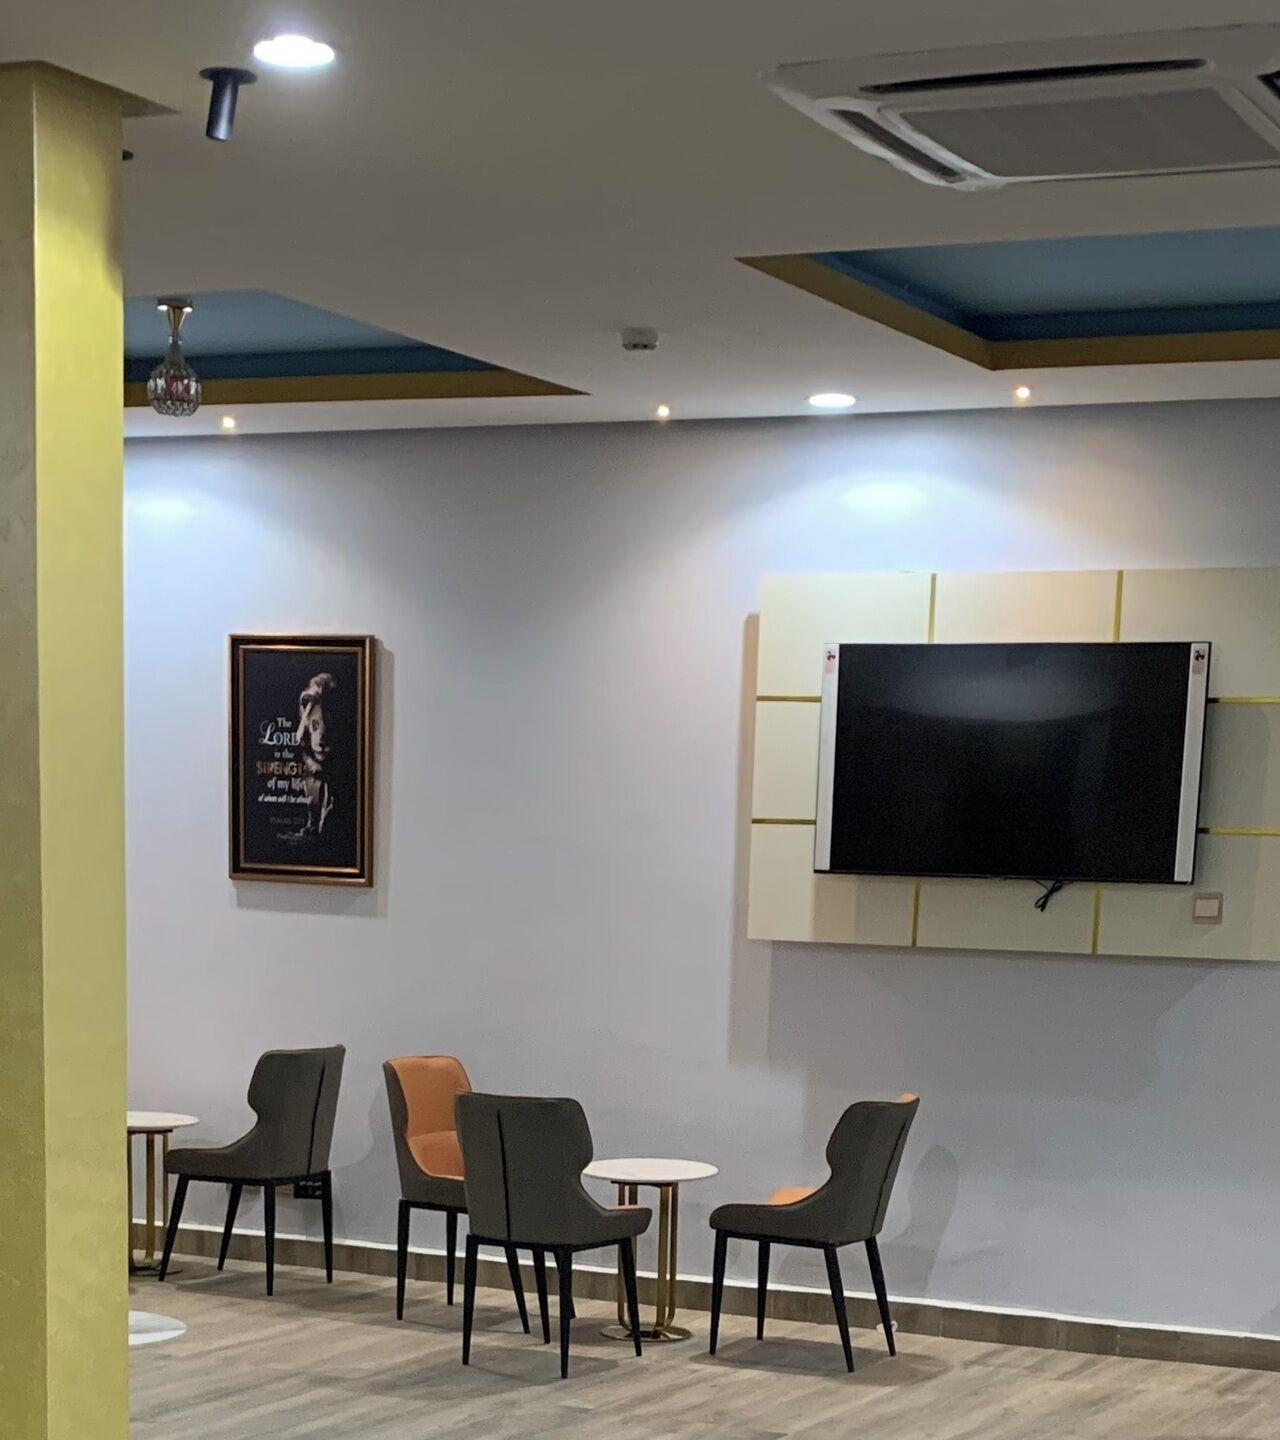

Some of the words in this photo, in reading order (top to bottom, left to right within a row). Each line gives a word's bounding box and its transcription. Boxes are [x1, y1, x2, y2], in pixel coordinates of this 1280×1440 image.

[277, 717, 292, 728] The
[267, 776, 277, 791] of
[277, 780, 290, 792] my
